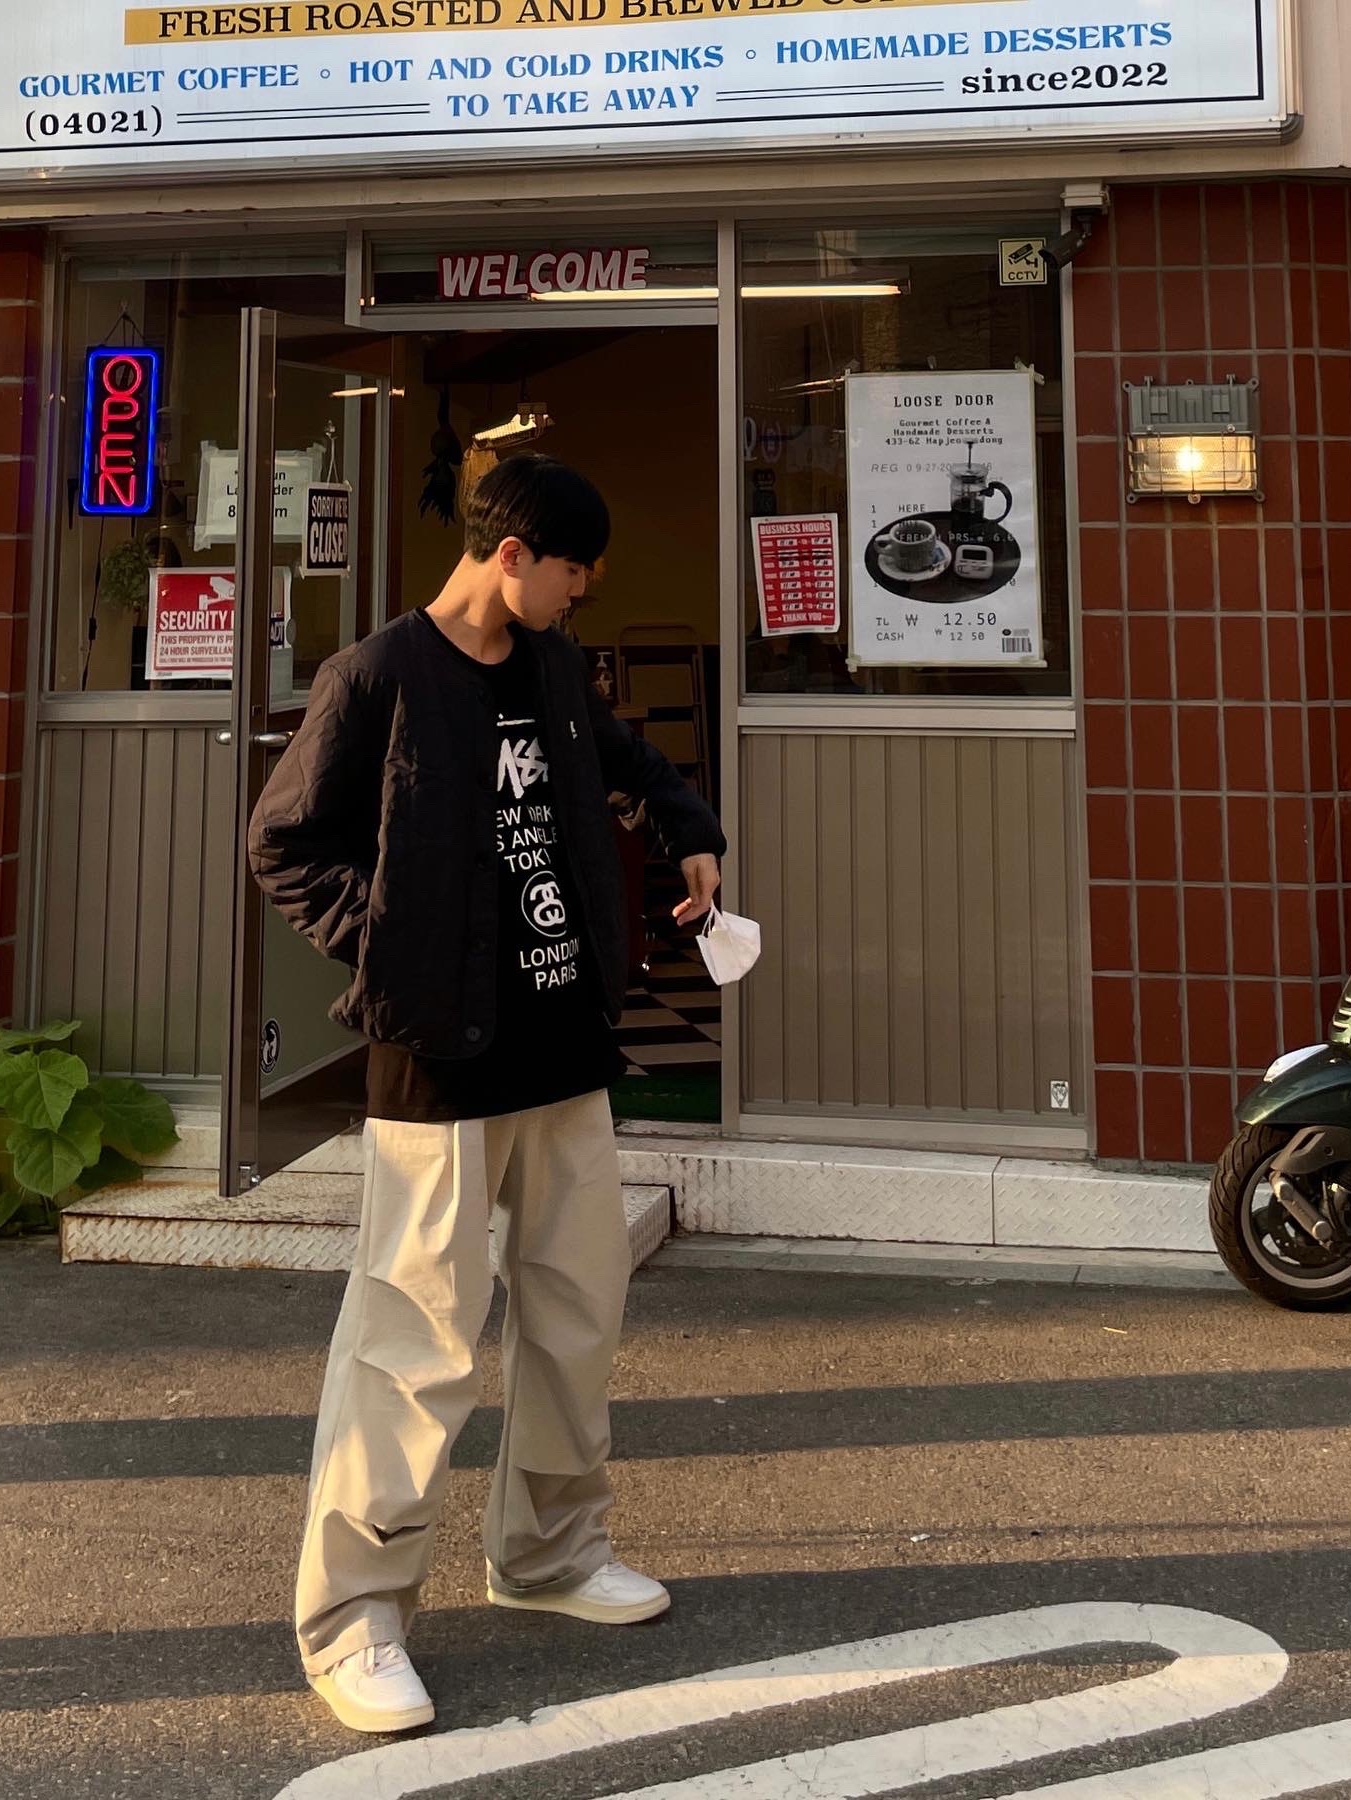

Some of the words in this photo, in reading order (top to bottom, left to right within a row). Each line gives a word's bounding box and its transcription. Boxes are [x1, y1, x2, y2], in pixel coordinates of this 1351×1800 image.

[159, 6, 292, 38] FRESH
[305, 0, 502, 31] ROASTED
[516, 0, 606, 23] AND
[19, 70, 165, 98] GOURMET
[178, 64, 299, 91] COFFEE
[350, 59, 413, 84] HOT
[427, 57, 492, 81] AND
[505, 53, 591, 78] COLD
[604, 45, 724, 74] DRINKS
[776, 31, 969, 64] HOMEMADE
[983, 22, 1172, 54] DESSERTS
[961, 61, 1169, 95] since2022
[447, 94, 490, 117] TO
[503, 90, 590, 116] TAKE
[603, 84, 700, 112] AWAY
[25, 105, 163, 142] (04021)
[441, 248, 650, 298] WELCOME
[1007, 270, 1039, 281] CCTV
[893, 395, 943, 408] LOOSE
[955, 394, 994, 407] DOOR
[98, 355, 143, 507] OPEN
[893, 428, 940, 436] Handmade
[947, 427, 994, 435] Desserts
[899, 418, 940, 428] Gourmet
[946, 418, 982, 427] Coffee
[870, 463, 899, 473] REG
[311, 495, 334, 518] SORRY
[898, 504, 926, 513] HERE
[759, 523, 801, 535] BUSINESS
[801, 522, 830, 533] HOURS
[309, 521, 348, 563] CLOSED
[159, 610, 228, 631] SECURITY
[782, 613, 807, 623] THANK
[808, 612, 822, 622] YOU
[876, 617, 890, 626] TL
[943, 612, 997, 626] 12.50
[161, 635, 177, 645] THIS
[178, 635, 216, 645] PROPERTY
[217, 635, 224, 644] IS
[876, 632, 904, 642] CASH
[160, 647, 168, 656] 24
[170, 646, 189, 656] HOUR
[190, 646, 234, 656] SURVEILLAN
[496, 805, 521, 828] EW
[504, 847, 551, 873] TOK
[519, 936, 580, 969] LONDON
[534, 961, 577, 991] PARIS
